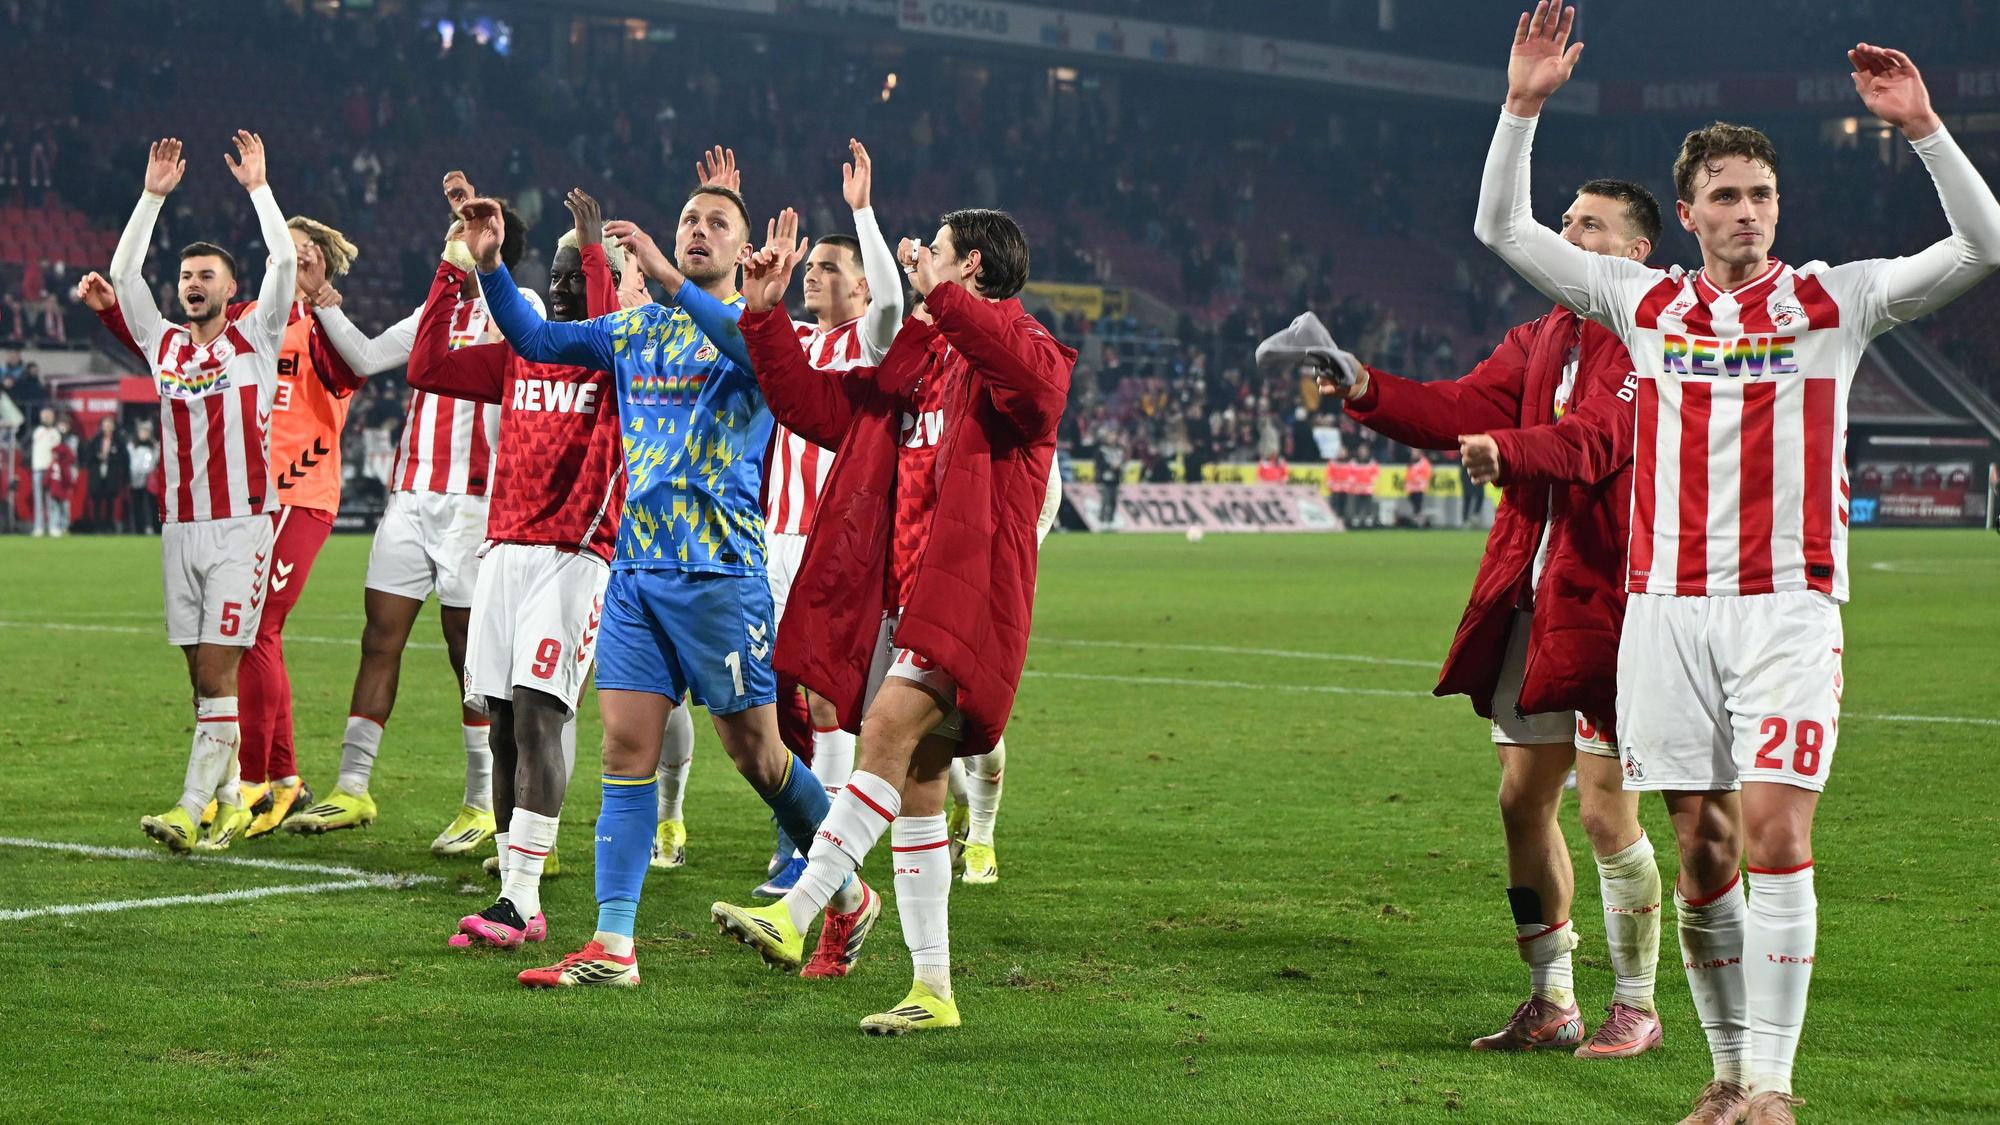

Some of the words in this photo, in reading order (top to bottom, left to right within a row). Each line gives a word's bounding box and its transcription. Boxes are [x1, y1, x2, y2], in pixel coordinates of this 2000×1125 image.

[931, 2, 1010, 34] OSMAB
[1644, 80, 1720, 109] REWE
[1796, 77, 1853, 103] REW
[1663, 333, 1799, 377] REWE
[512, 379, 598, 414] REWE
[1616, 371, 1638, 402] DE
[1121, 499, 1205, 526] PIZZA
[1202, 499, 1295, 526] WOLKE
[219, 601, 242, 637] 5
[531, 638, 562, 679] 9
[725, 651, 745, 696] 1
[1754, 717, 1824, 776] 28
